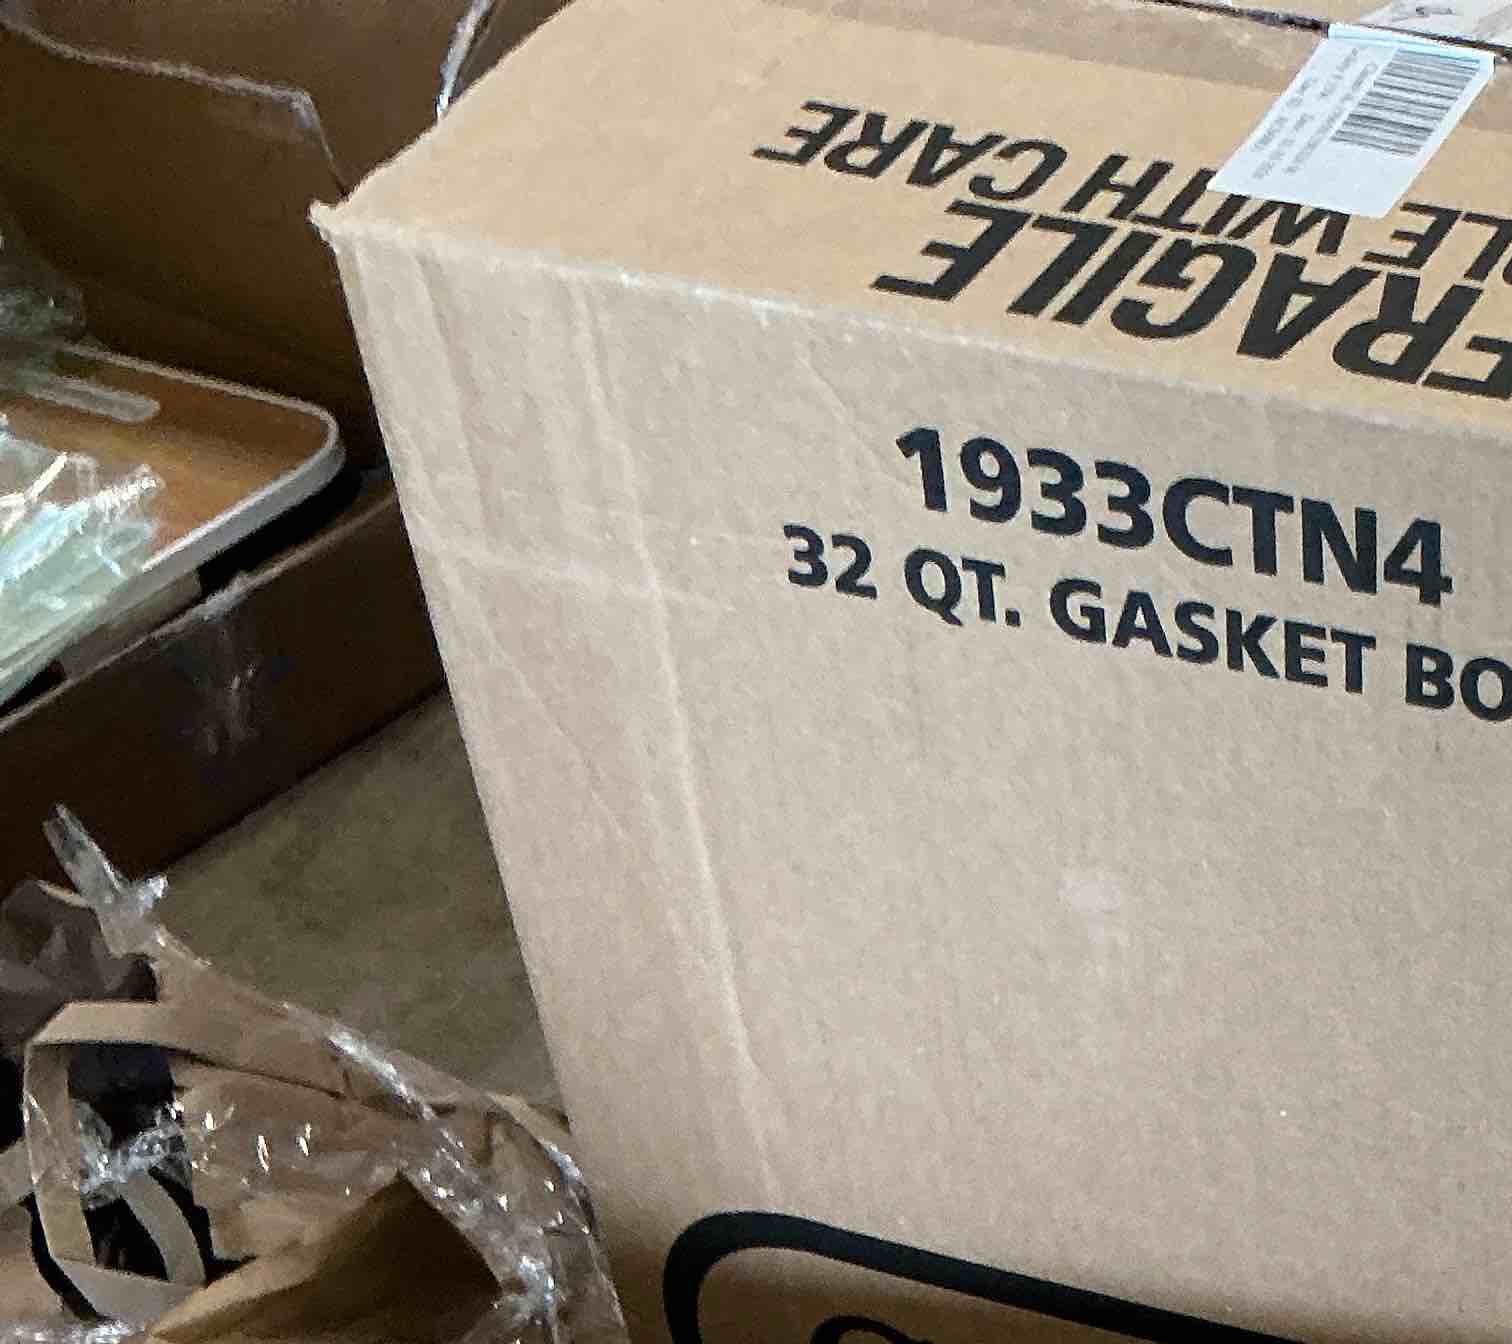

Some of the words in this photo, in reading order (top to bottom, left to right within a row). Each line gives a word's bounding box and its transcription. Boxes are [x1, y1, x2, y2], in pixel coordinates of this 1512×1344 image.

[753, 98, 1070, 200] CARE
[895, 426, 1452, 607] 1933CTN4
[782, 523, 877, 600] 32
[902, 548, 1022, 628] QT.
[1049, 576, 1376, 697] GASKET
